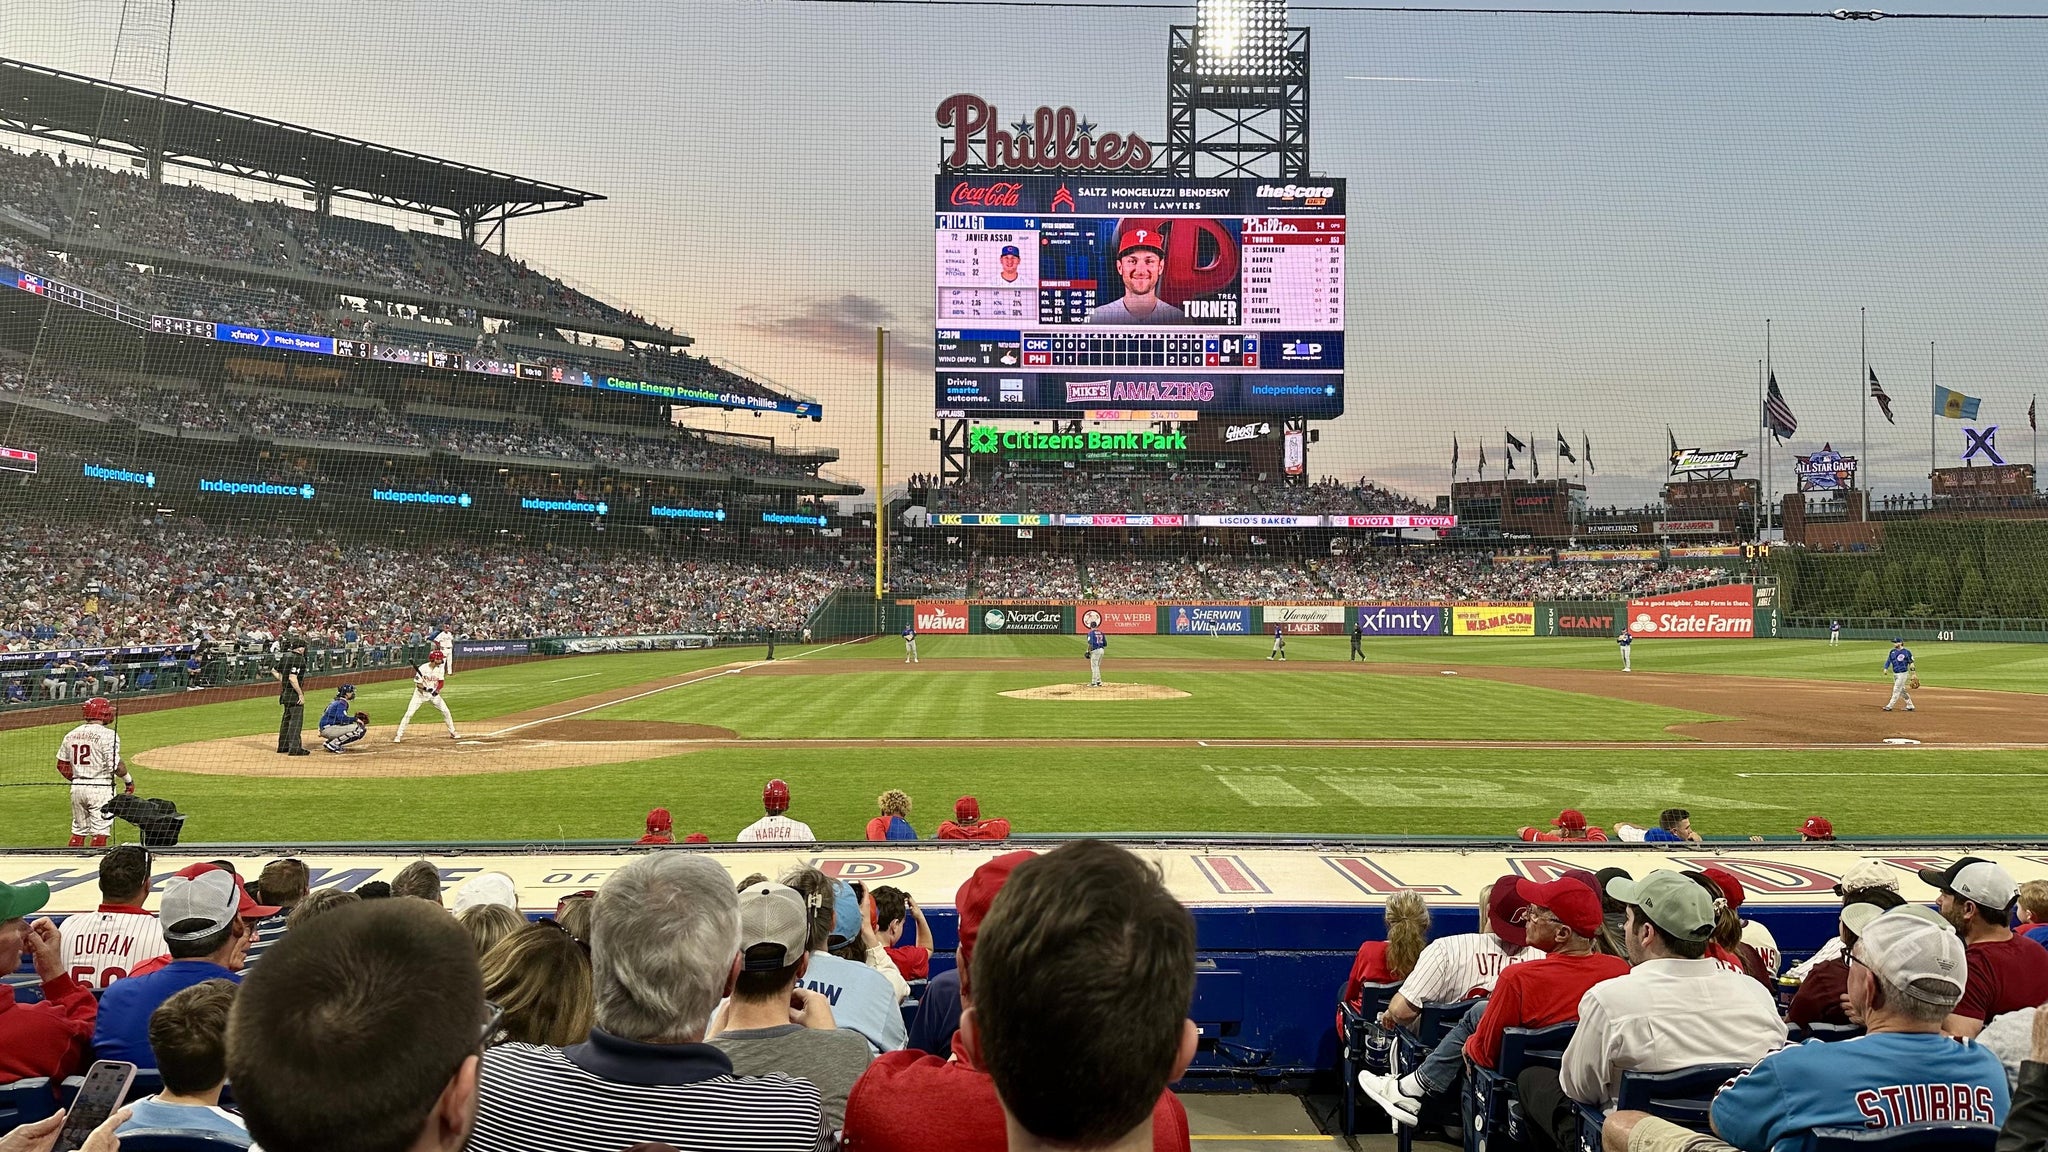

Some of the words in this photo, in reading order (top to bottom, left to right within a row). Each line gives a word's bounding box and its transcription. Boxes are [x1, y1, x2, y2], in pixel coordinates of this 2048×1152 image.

[935, 93, 1152, 170] Phillies
[1078, 188, 1107, 197] SALTZ
[1112, 188, 1175, 198] MONGELUZZI
[1180, 188, 1230, 198] BENDESKY
[1256, 184, 1334, 198] theScore
[1108, 202, 1145, 210] INJURY
[1154, 202, 1201, 210] LAWYERS
[940, 215, 984, 230] CHICAGO
[1243, 218, 1298, 233] Phillies
[990, 234, 1012, 242] ASSAD
[25, 274, 38, 285] CHC
[1183, 300, 1237, 318] TURNER
[155, 320, 161, 328] R
[175, 322, 182, 330] H
[231, 330, 259, 341] xfinity
[275, 336, 294, 346] Pitch
[295, 338, 319, 349] Speed
[339, 341, 353, 349] MIA
[1223, 339, 1240, 353] 0-1
[339, 348, 352, 356] ATL
[957, 356, 976, 364] (MPH)
[607, 377, 638, 390] Clean
[640, 382, 675, 398] Energy
[677, 386, 718, 400] Provider
[720, 393, 730, 403] of
[731, 394, 746, 405] the
[747, 396, 777, 409] Phillies
[1071, 386, 1107, 397] MIKE'S
[1113, 382, 1214, 402] AMAZING
[1252, 385, 1322, 396] Independence
[1225, 424, 1260, 441] GHOST
[1002, 430, 1084, 450] Citizens
[1088, 430, 1139, 450] Bank
[1143, 430, 1187, 450] Park
[1678, 450, 1738, 465] Fitzpatrick
[84, 463, 144, 484] Independence
[1796, 463, 1811, 473] ALL
[1812, 463, 1832, 472] STAR
[1833, 462, 1856, 471] GAME
[200, 479, 297, 496] Independence
[373, 488, 456, 504] Independence
[522, 498, 594, 513] Independence
[652, 505, 714, 519] Independence
[762, 512, 817, 525] Independence
[939, 515, 962, 525] UKG
[979, 515, 1001, 525] UKG
[1018, 515, 1040, 525] UKG
[1006, 611, 1061, 623] NovaCare
[1105, 613, 1123, 621] F.W.
[1126, 613, 1151, 621] WEBB
[1192, 608, 1241, 619] SHERWIN
[1279, 608, 1328, 621] Yuengling
[1363, 610, 1435, 631] xfinity
[918, 615, 966, 629] Wawa
[1288, 624, 1320, 632] LAGER
[1559, 616, 1613, 628] GIANT
[1938, 632, 1954, 640] 401
[72, 744, 90, 765] 12
[756, 826, 790, 840] HARPER
[543, 873, 607, 884] OF
[75, 934, 134, 957] DURAN
[1855, 1084, 1995, 1129] STUBBS
